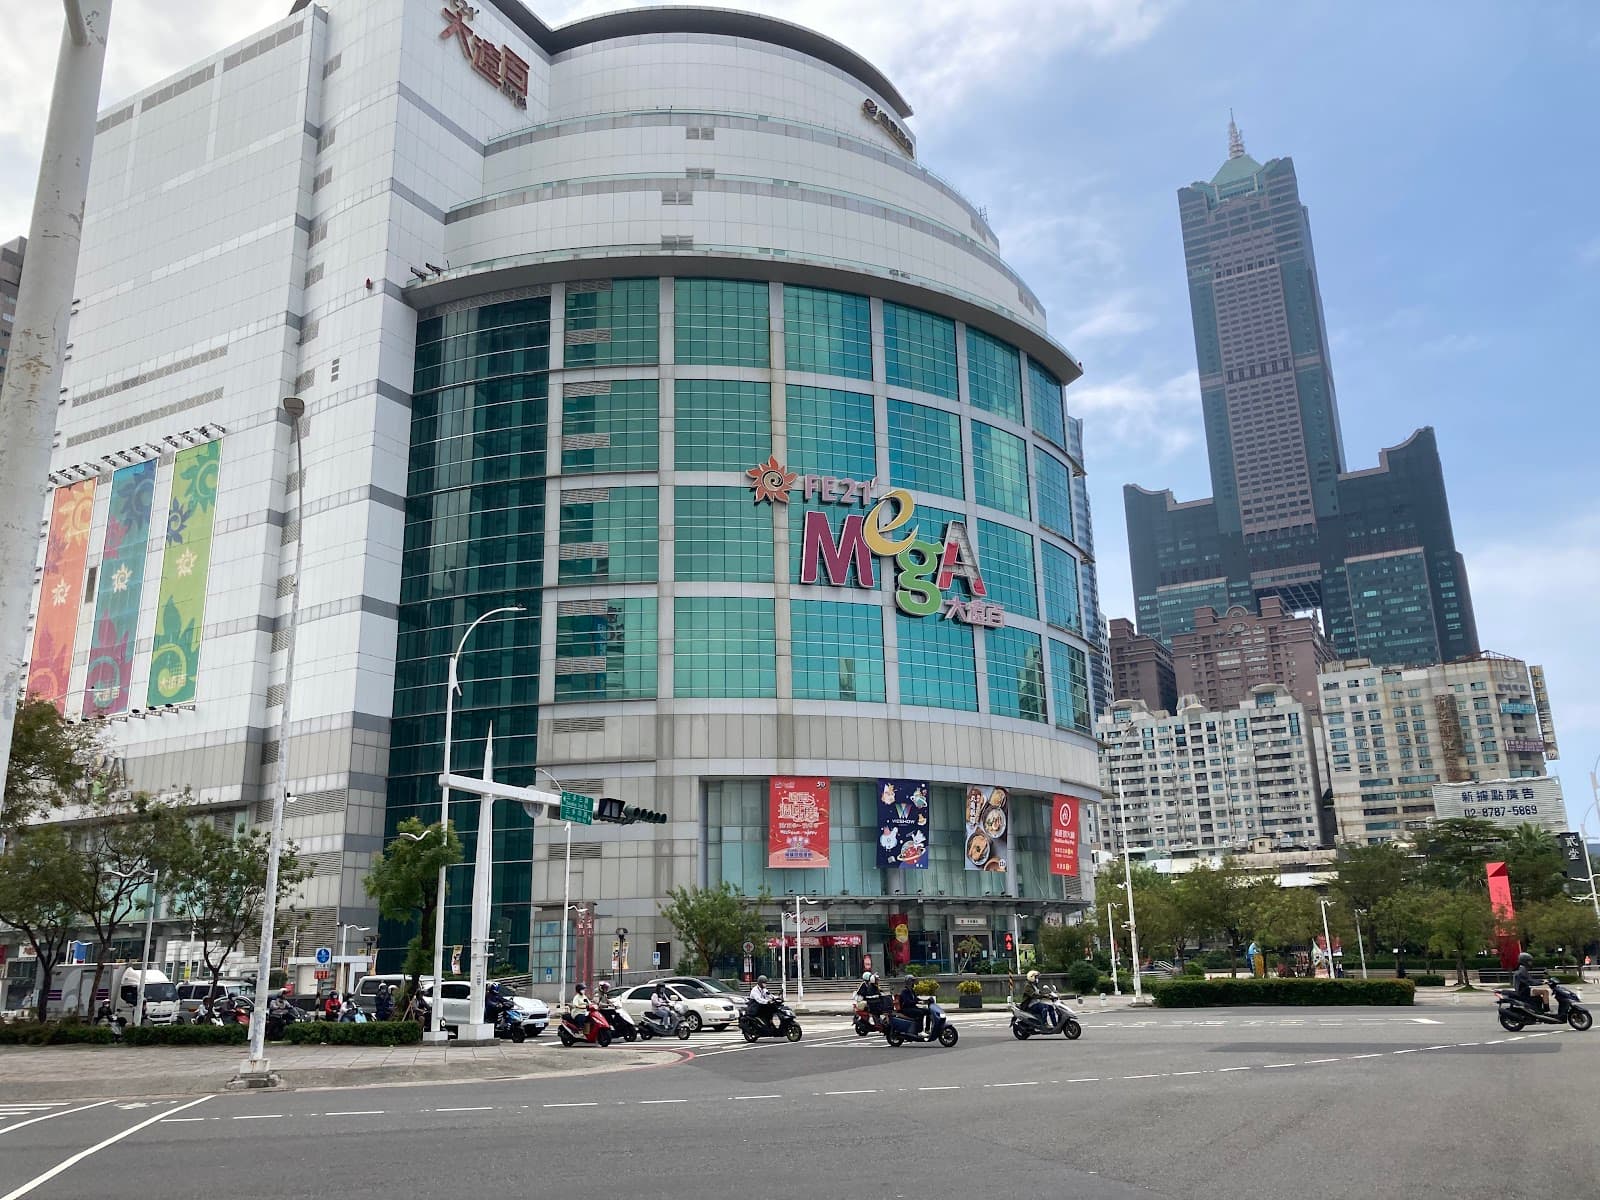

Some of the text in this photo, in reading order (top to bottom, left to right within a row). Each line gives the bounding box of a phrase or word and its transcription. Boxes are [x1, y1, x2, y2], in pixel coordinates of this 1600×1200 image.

[439, 8, 530, 97] 大遠百
[945, 597, 1005, 629] 大遠百
